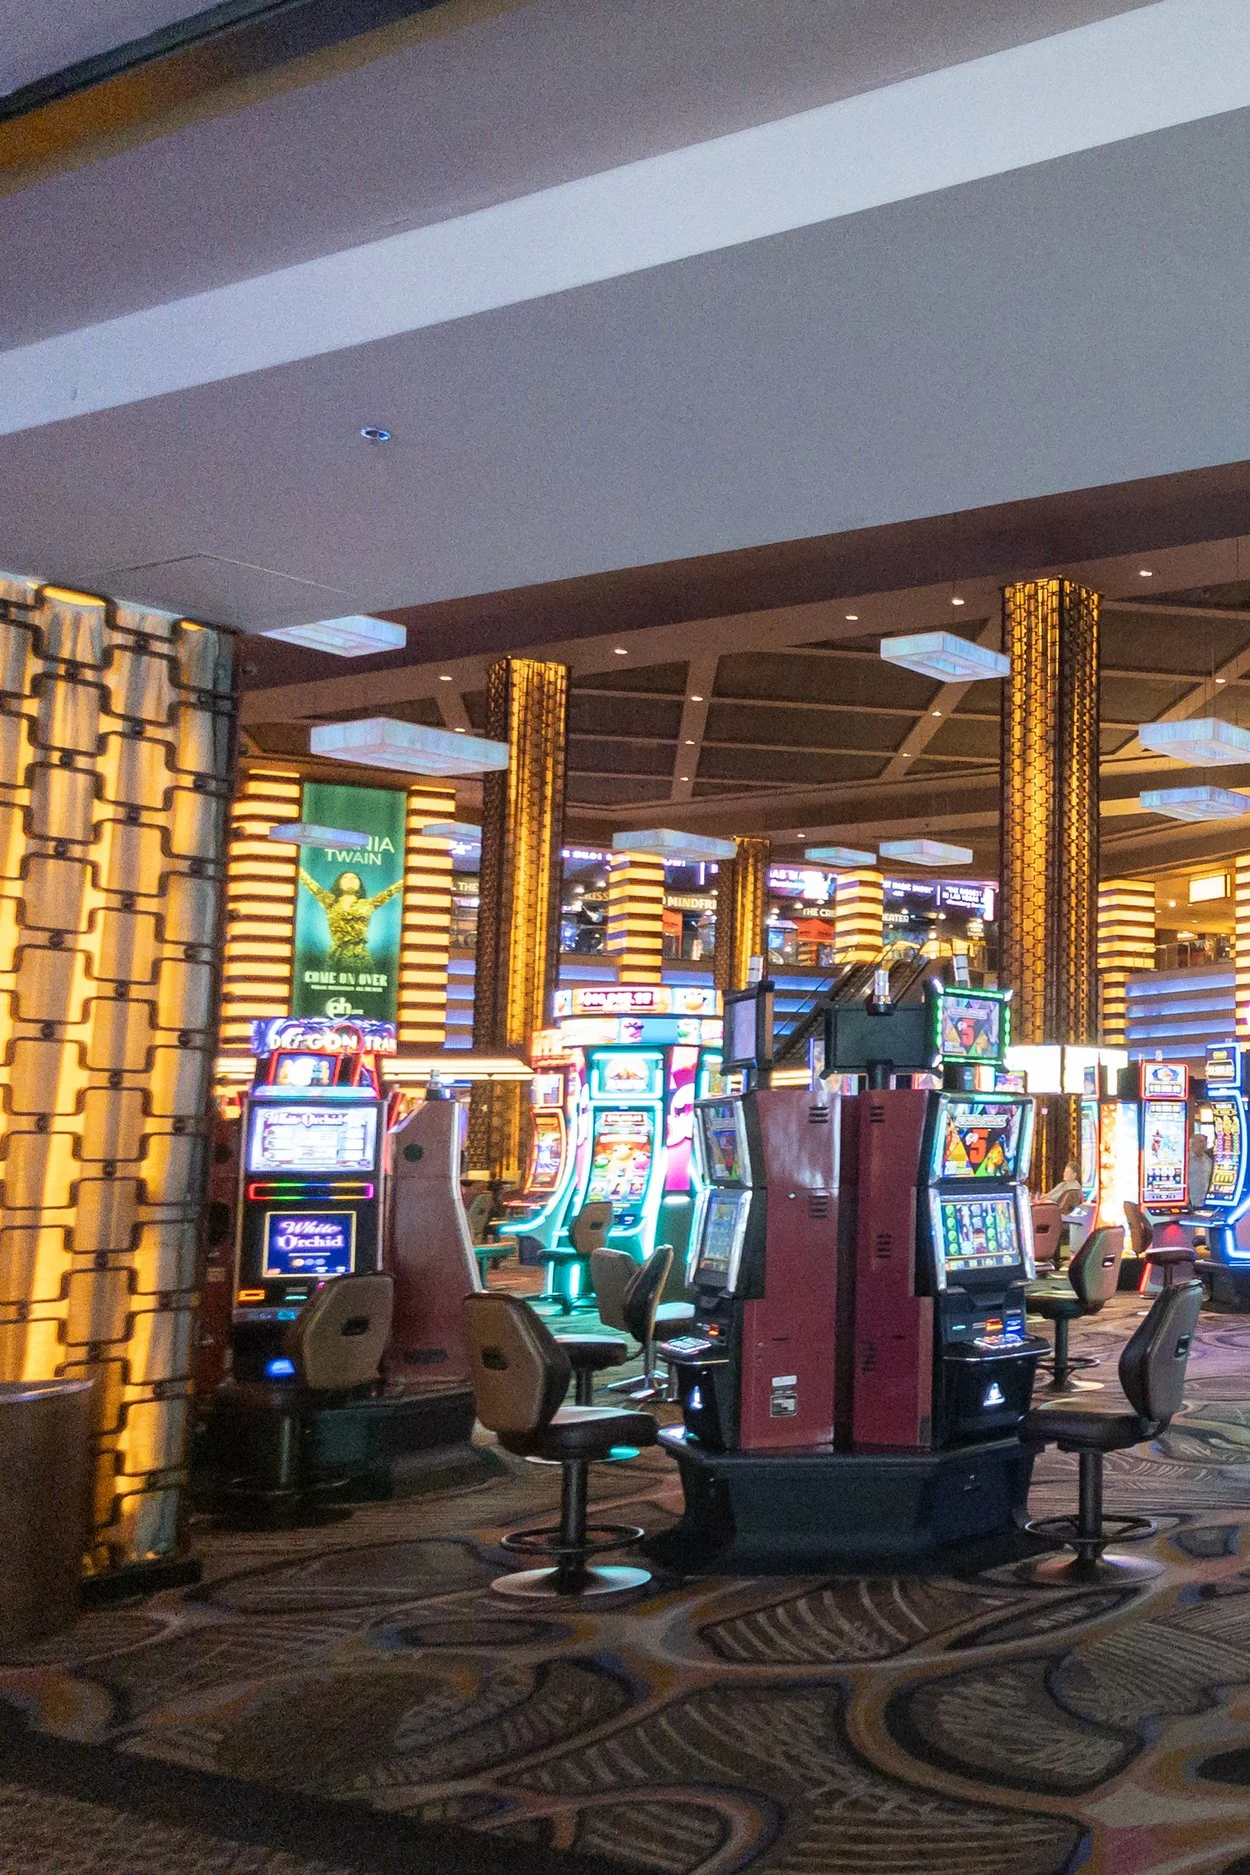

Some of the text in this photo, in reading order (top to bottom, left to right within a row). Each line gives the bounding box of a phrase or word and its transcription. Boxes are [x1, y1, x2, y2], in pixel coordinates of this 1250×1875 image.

[325, 848, 381, 865] TWAIN
[803, 907, 819, 916] THE
[304, 970, 388, 987] COME ON OVER
[280, 1220, 342, 1234] White
[278, 1234, 344, 1249] Orchid
